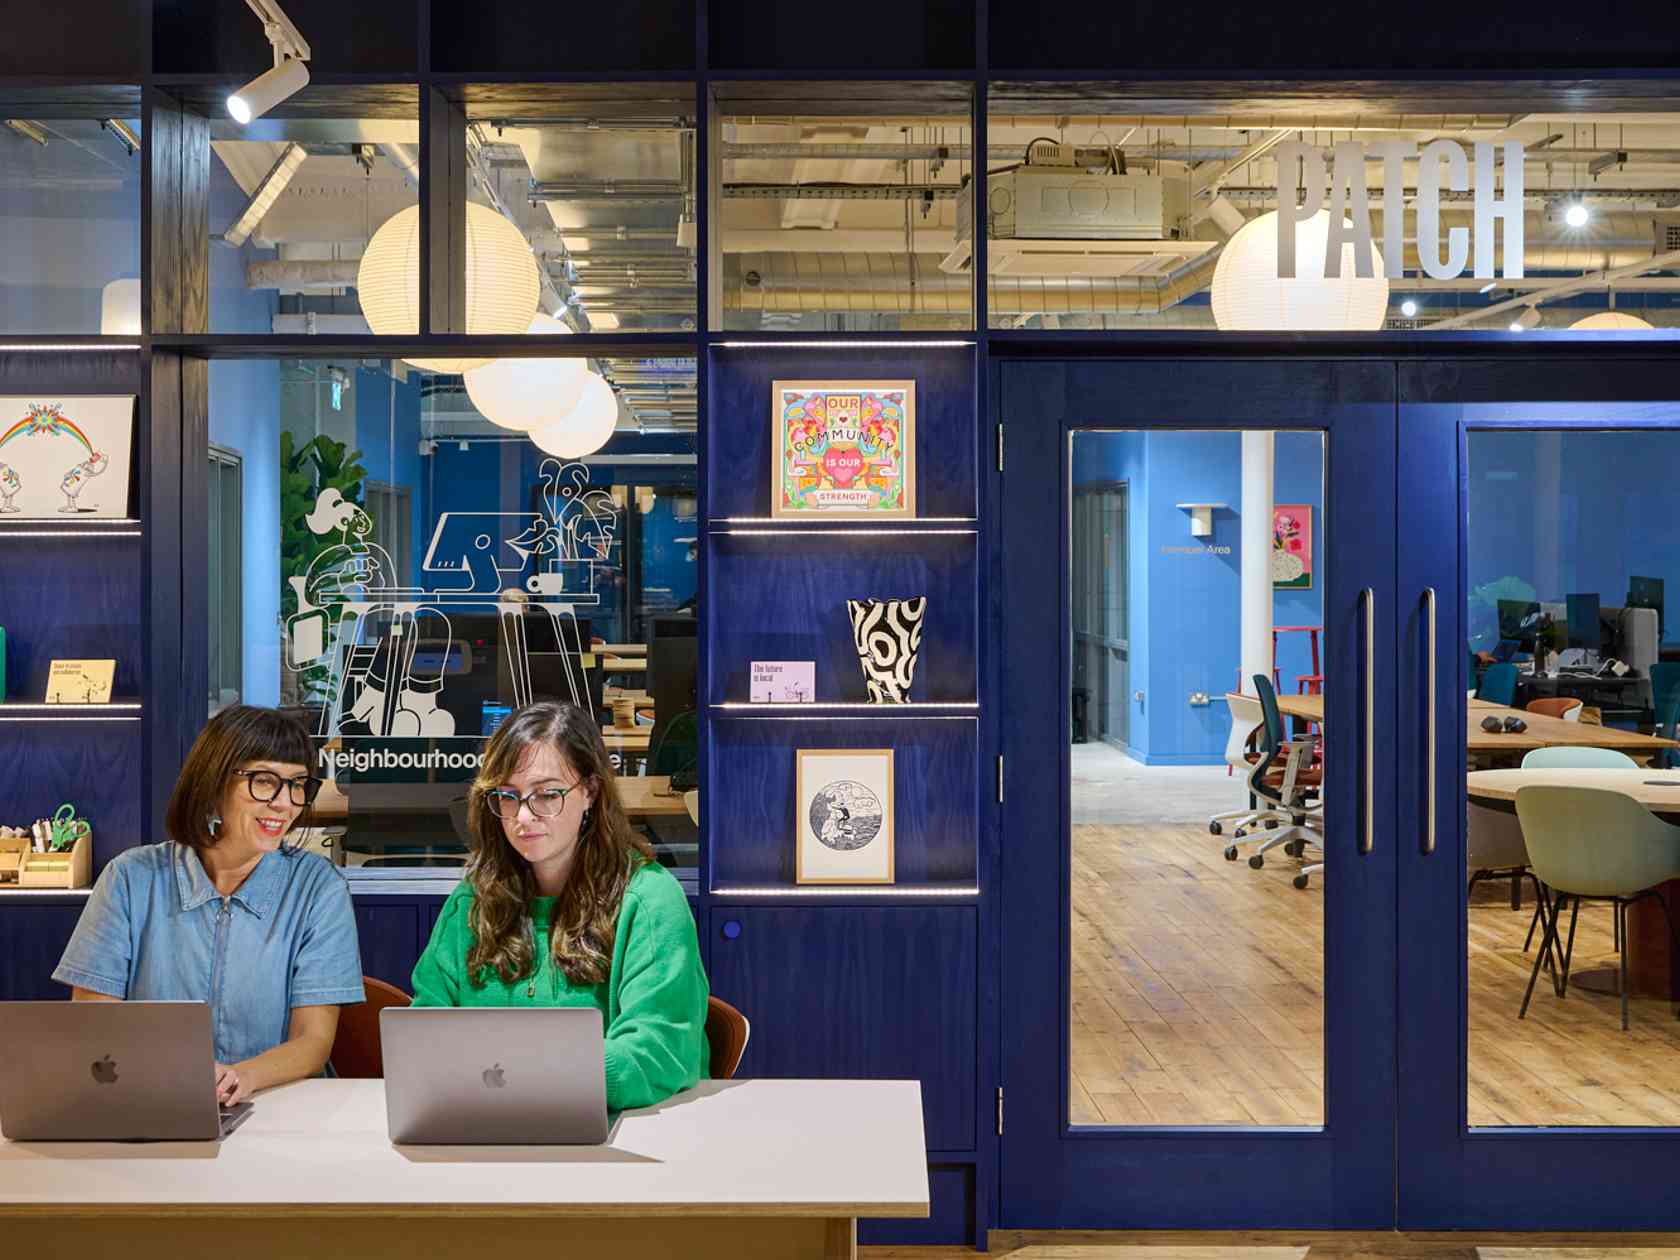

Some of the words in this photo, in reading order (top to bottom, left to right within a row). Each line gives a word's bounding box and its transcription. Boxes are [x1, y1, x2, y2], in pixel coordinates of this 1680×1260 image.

[1277, 138, 1525, 280] PATCH
[828, 398, 859, 409] OUR
[795, 429, 893, 451] COMMUNITY
[826, 459, 836, 467] IS
[839, 458, 860, 467] OUR
[819, 493, 868, 501] STRENGTH
[1207, 545, 1232, 554] Area
[754, 663, 764, 673] The
